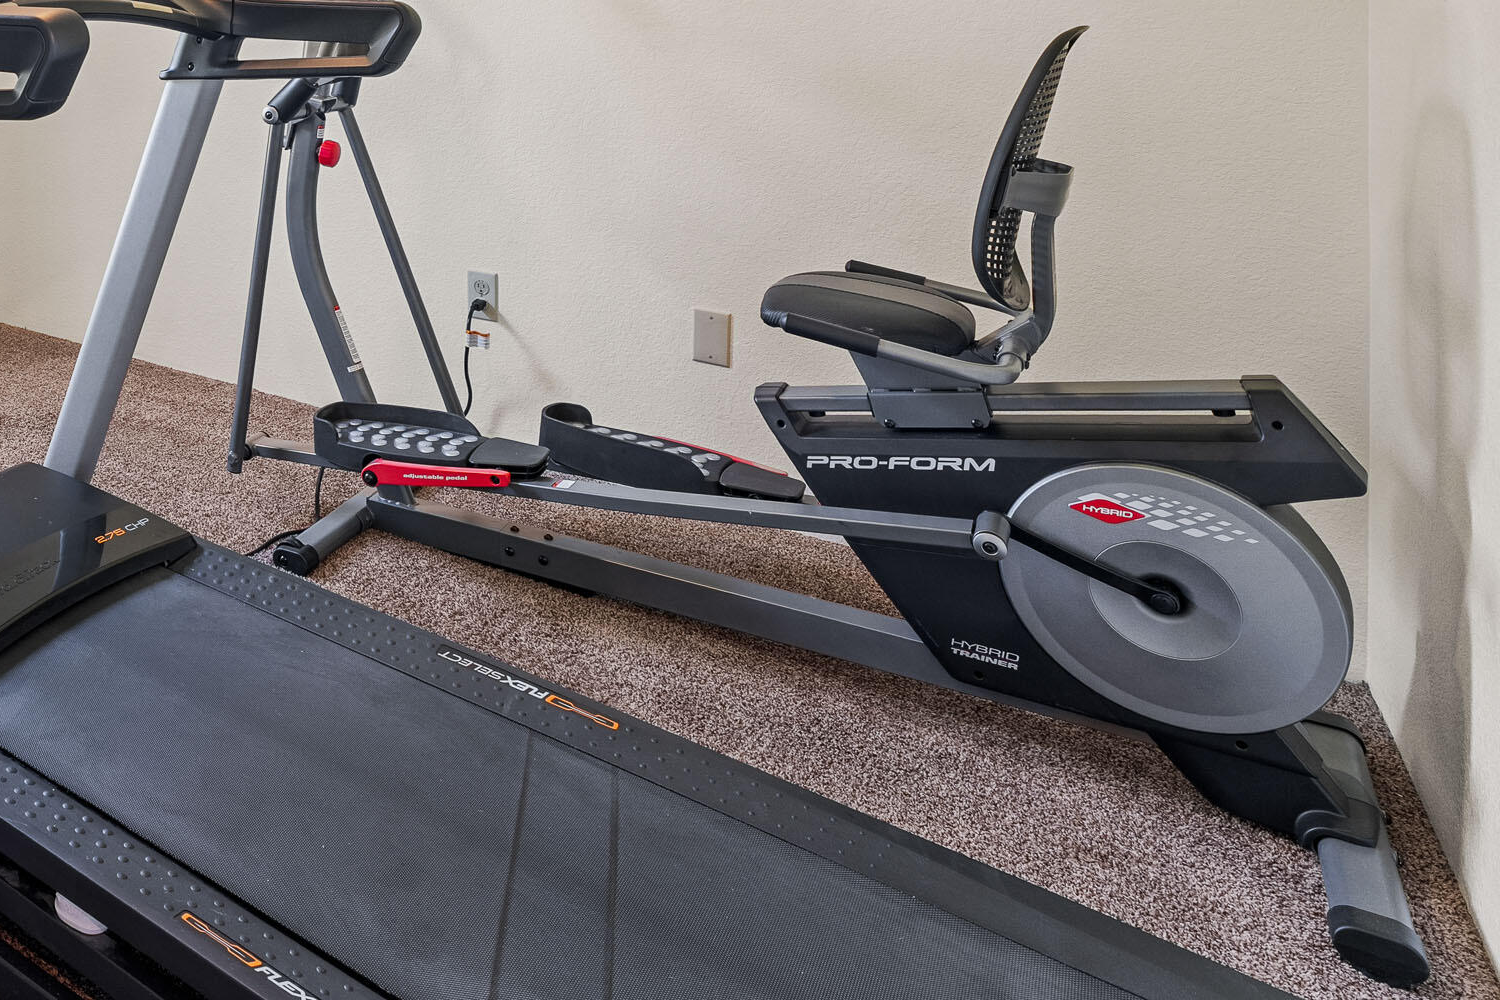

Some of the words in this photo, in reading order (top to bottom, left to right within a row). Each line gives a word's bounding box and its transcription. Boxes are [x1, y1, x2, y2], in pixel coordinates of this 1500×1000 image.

[806, 455, 996, 472] PRO-FORM
[1082, 504, 1133, 518] HYBRID
[124, 517, 149, 531] CHP
[951, 638, 1020, 662] HYBRID
[950, 647, 1018, 671] TRAINER
